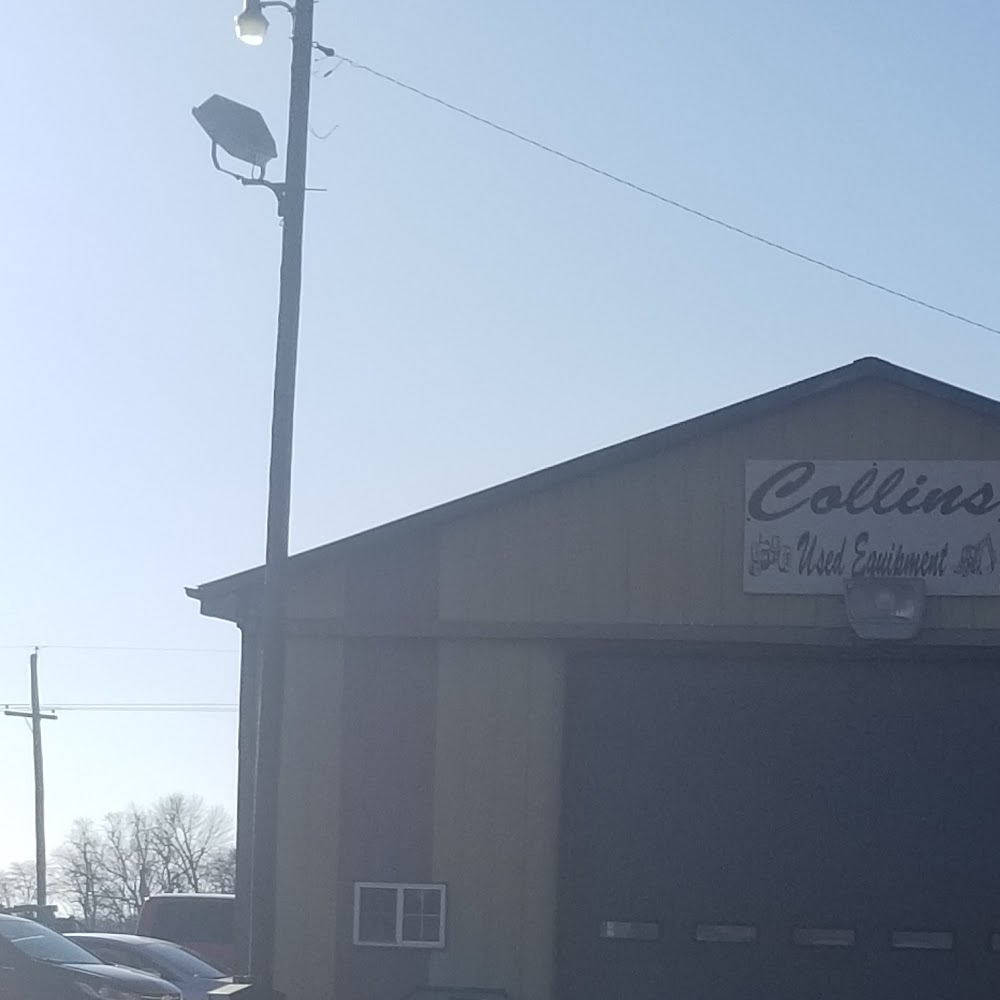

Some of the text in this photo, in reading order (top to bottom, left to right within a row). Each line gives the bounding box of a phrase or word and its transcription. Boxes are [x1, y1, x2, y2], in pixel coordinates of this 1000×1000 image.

[748, 461, 1000, 521] Collins
[797, 531, 949, 578] Used Equipment
